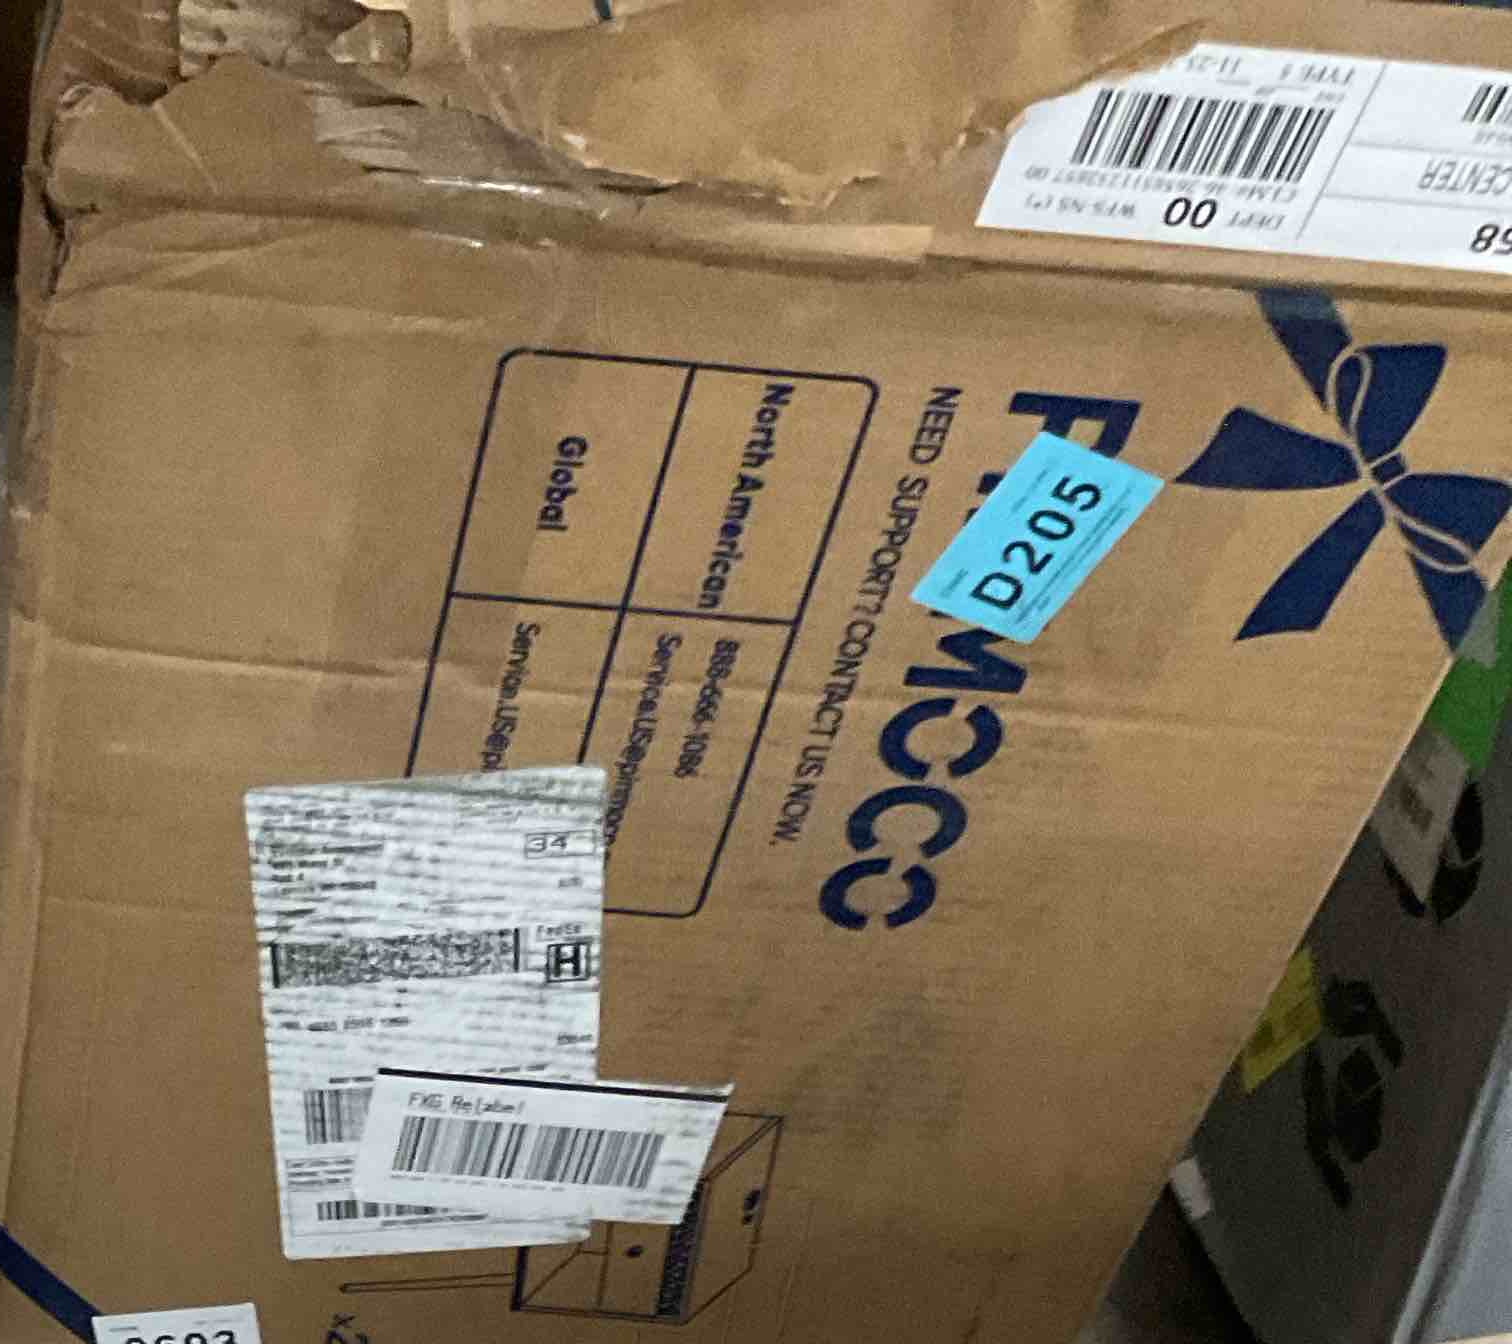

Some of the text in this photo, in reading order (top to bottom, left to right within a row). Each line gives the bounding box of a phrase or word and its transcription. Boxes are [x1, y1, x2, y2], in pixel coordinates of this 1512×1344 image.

[1162, 196, 1218, 230] 00
[1418, 159, 1512, 196] CENTER
[536, 435, 588, 531] Global
[697, 384, 796, 609] North American
[969, 475, 1103, 610] D205
[768, 386, 964, 846] NEED SUPPORT? CONTACT US NOW.
[816, 392, 1142, 932] PMOCO
[553, 944, 582, 978] H
